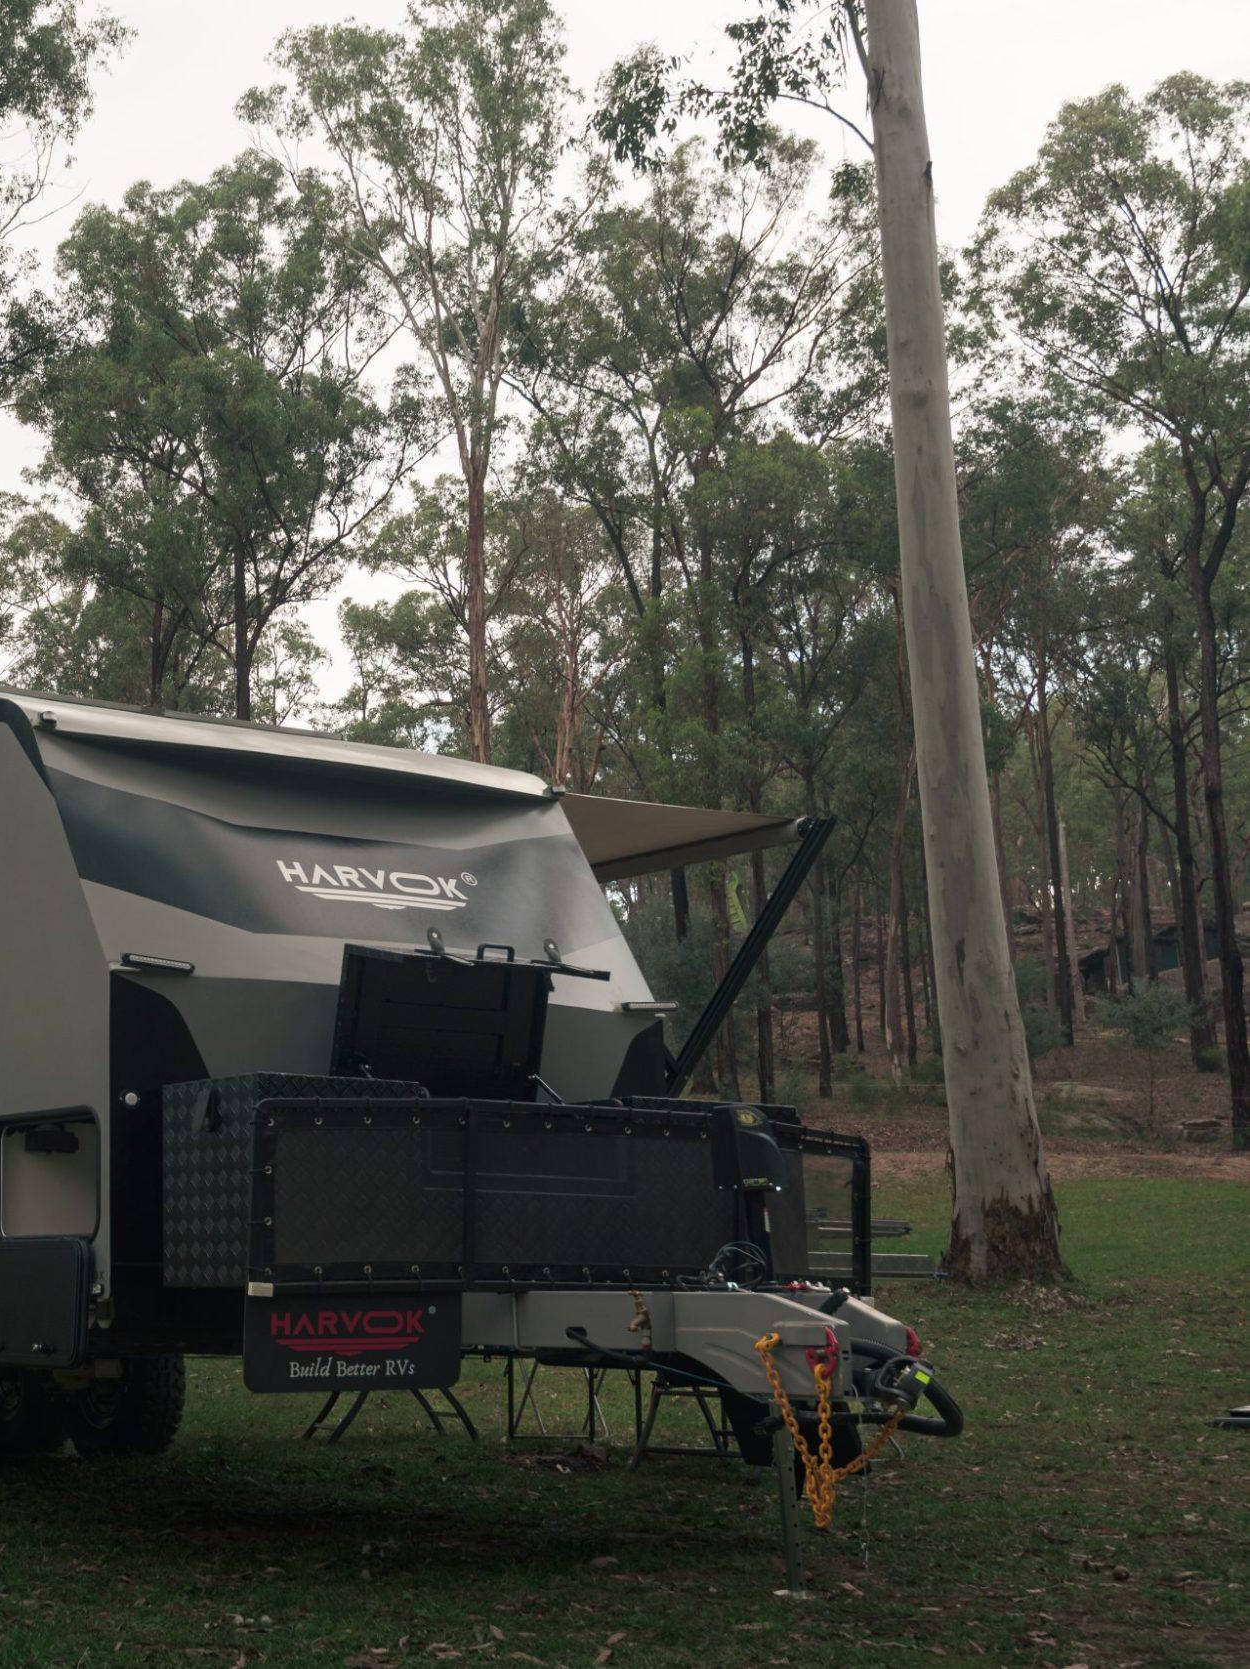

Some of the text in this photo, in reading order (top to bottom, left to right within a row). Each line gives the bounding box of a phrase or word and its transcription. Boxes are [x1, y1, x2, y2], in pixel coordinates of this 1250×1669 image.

[270, 1309, 425, 1336] HARVOK
[289, 1357, 415, 1378] Build Better RVs
